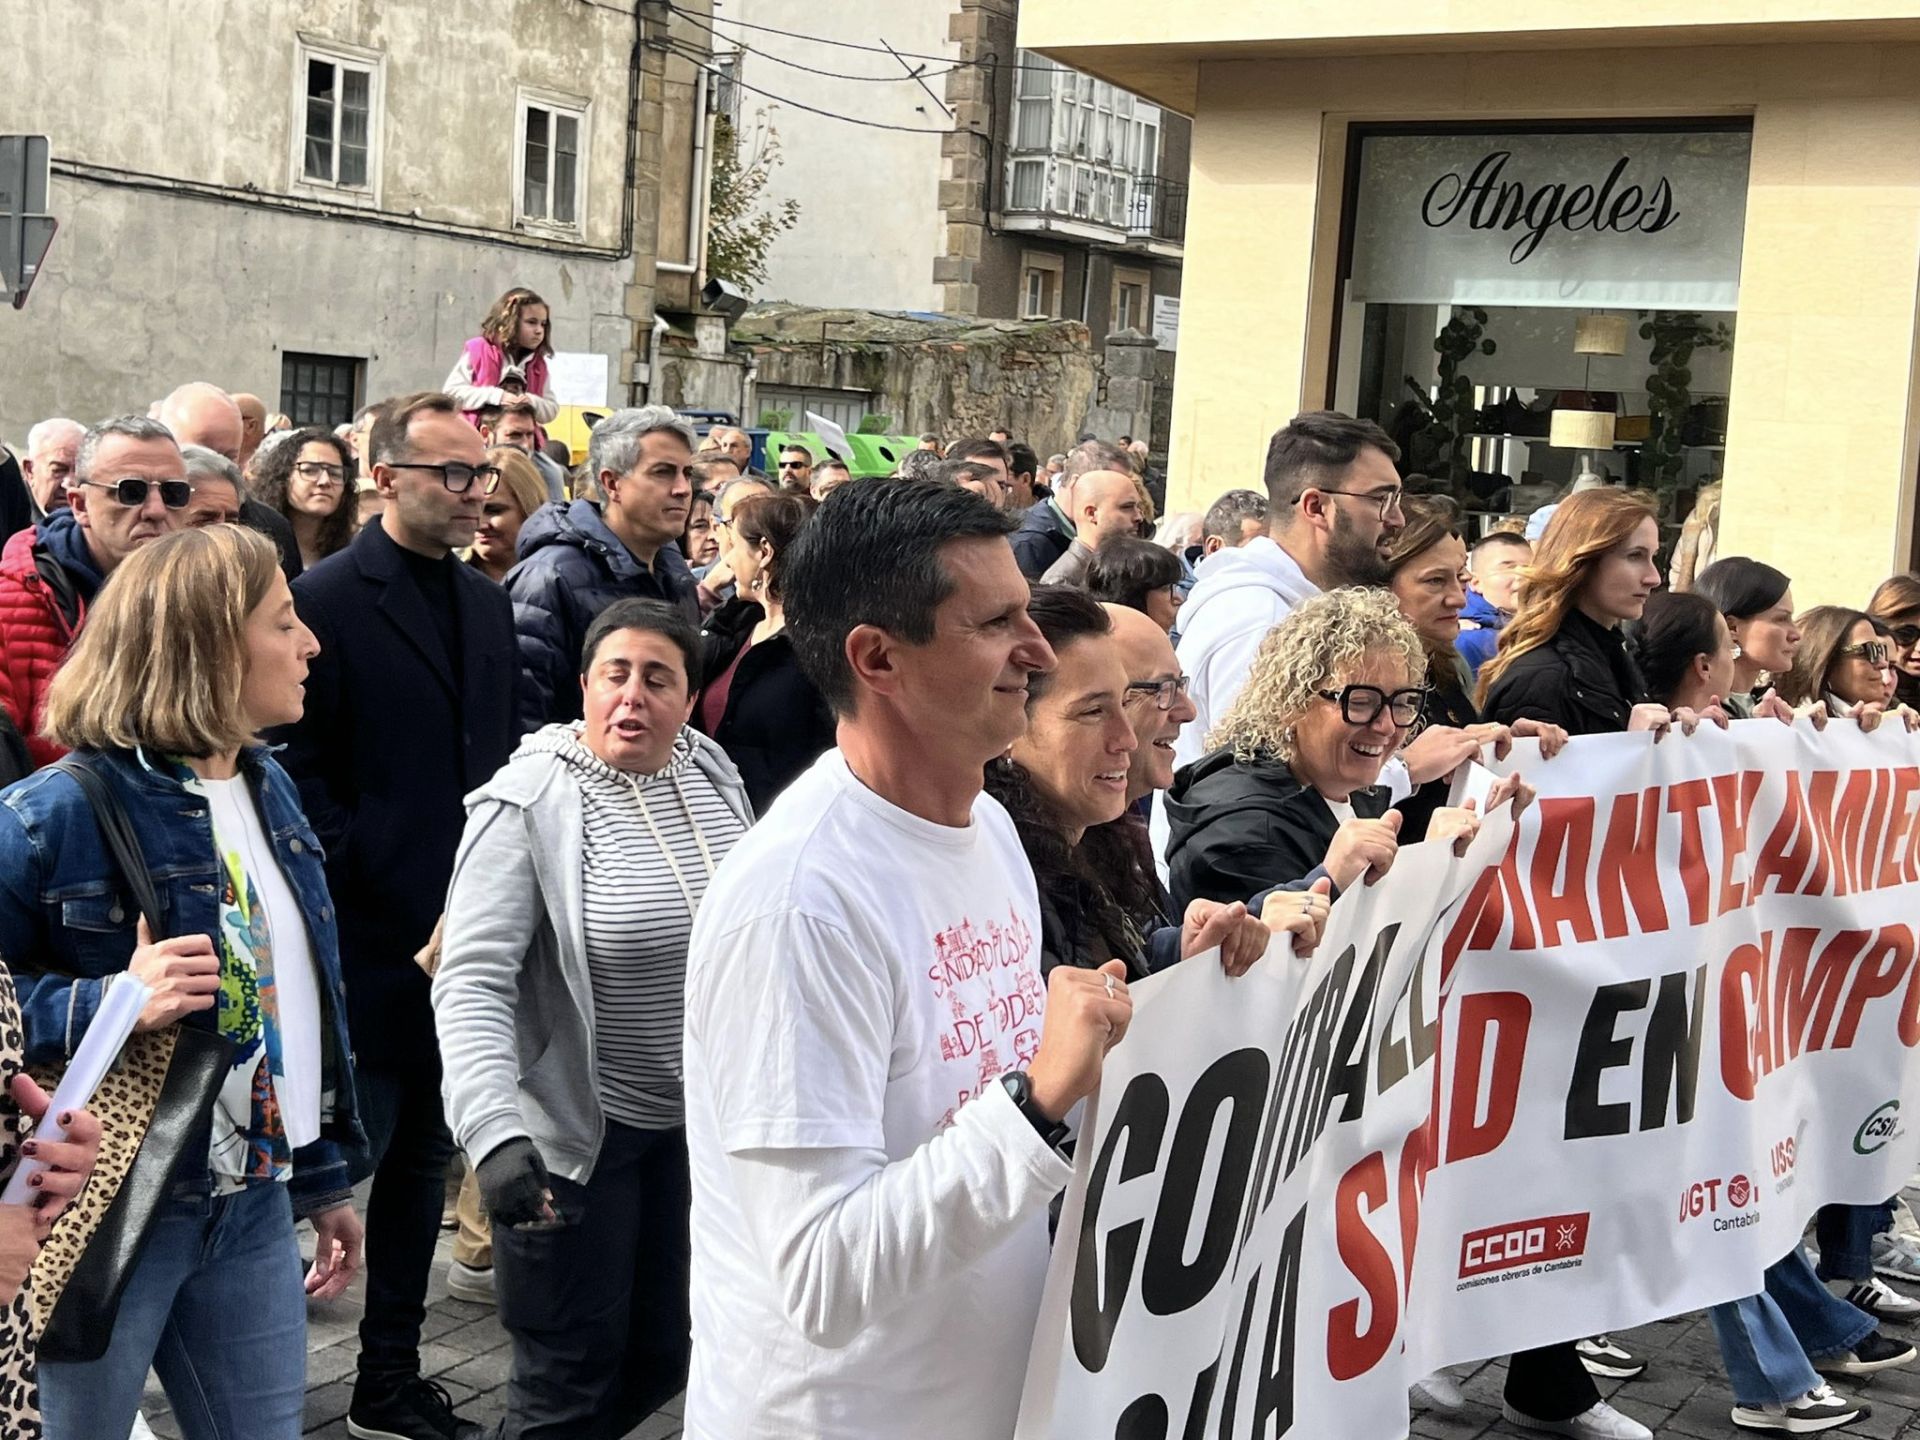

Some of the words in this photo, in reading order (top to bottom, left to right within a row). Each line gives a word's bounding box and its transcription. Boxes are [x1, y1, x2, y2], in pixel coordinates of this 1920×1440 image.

[1421, 150, 1681, 265] Angeles
[928, 938, 994, 999] SNIDAD
[953, 1011, 992, 1057] DE
[1563, 962, 1708, 1141] EN
[1679, 1178, 1722, 1223] UGT
[1713, 1209, 1760, 1232] Cantabria
[1464, 1226, 1546, 1268] CCOO
[1456, 1273, 1500, 1292] comisiones
[1501, 1268, 1531, 1282] obreras
[1531, 1263, 1543, 1275] de
[1544, 1257, 1583, 1273] Cantabria
